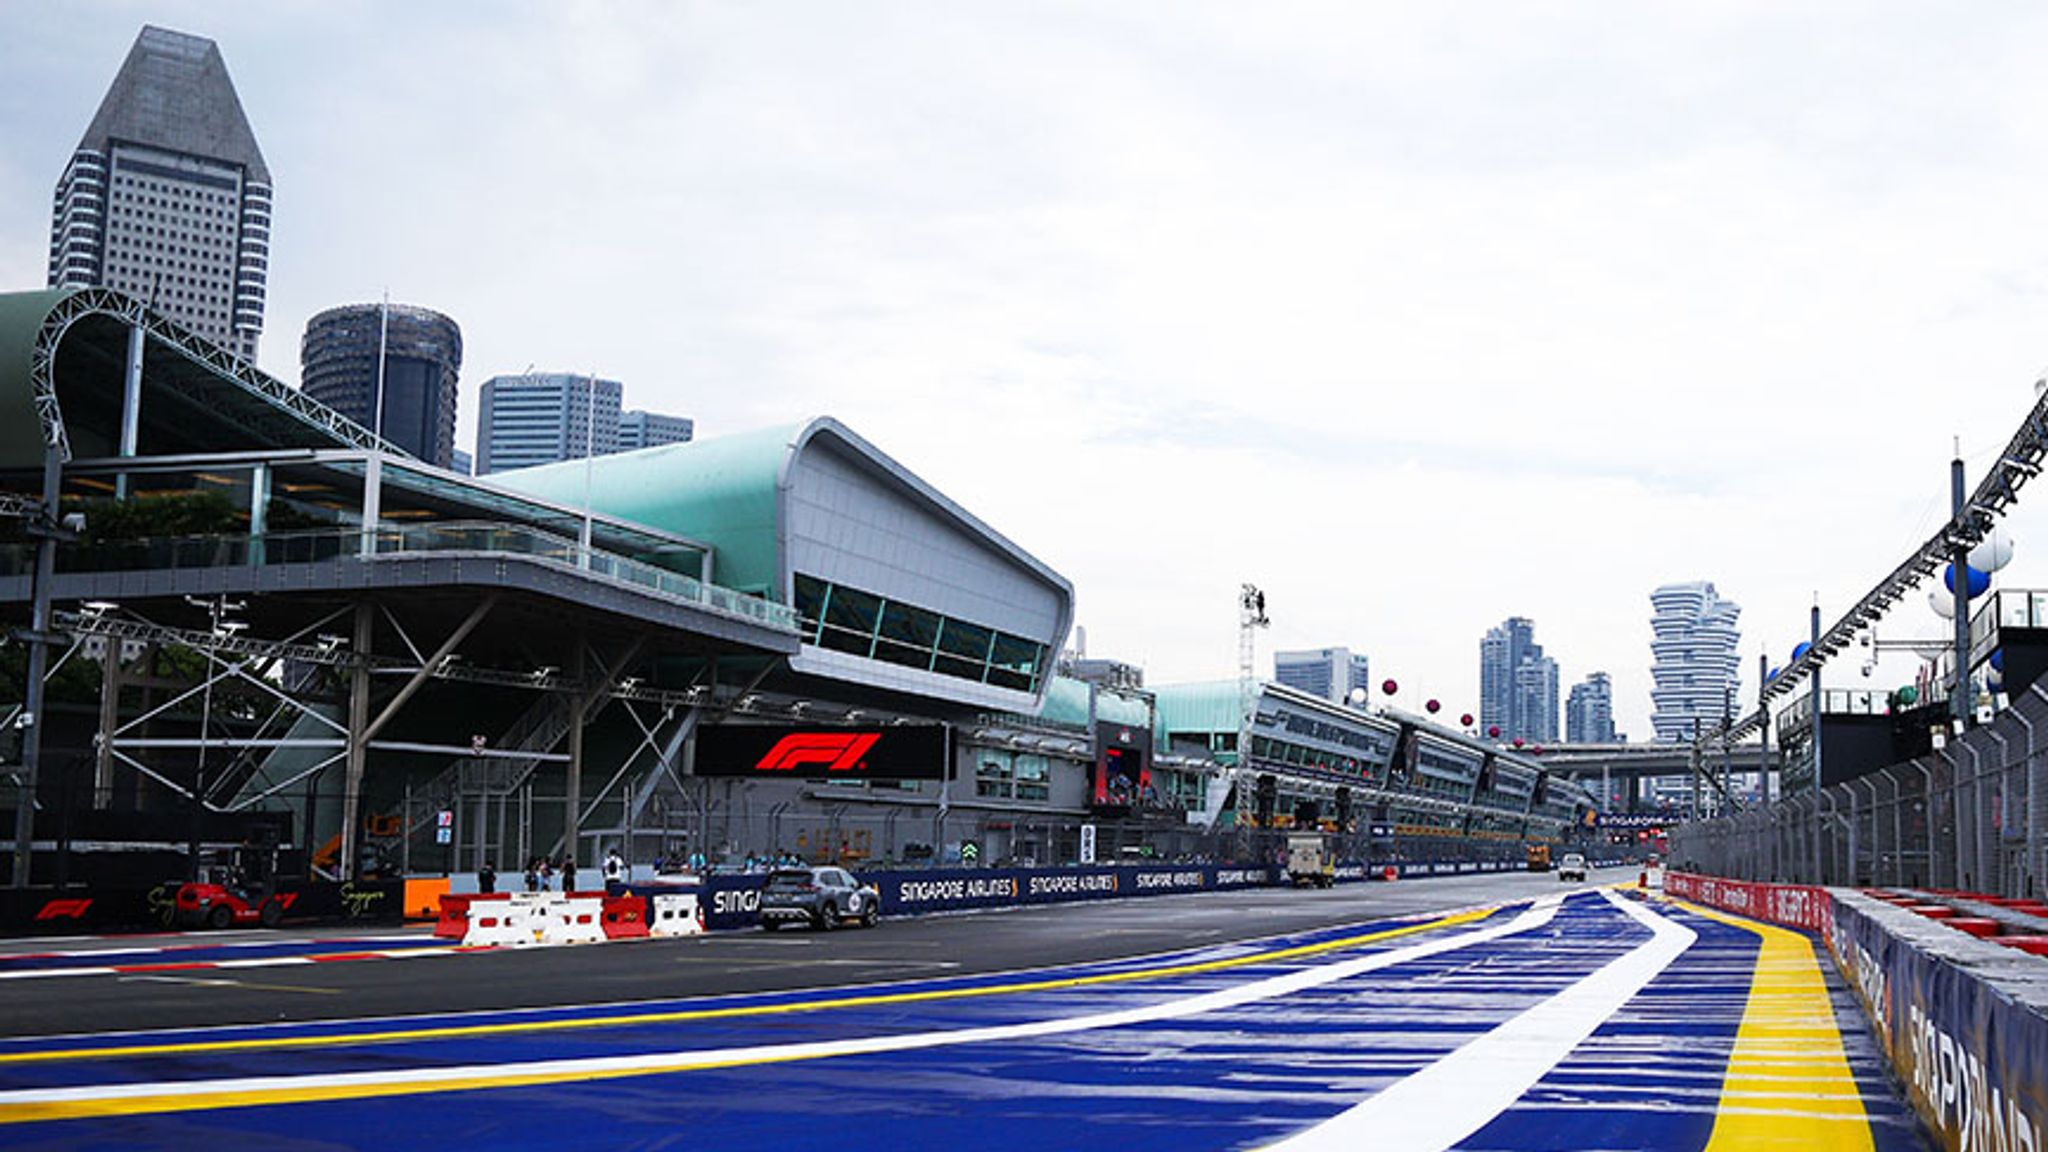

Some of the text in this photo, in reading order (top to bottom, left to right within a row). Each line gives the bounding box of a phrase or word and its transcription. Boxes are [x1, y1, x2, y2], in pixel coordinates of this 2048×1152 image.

[755, 732, 882, 770] F1
[900, 878, 1011, 902] SINGAPORE AIRLINES
